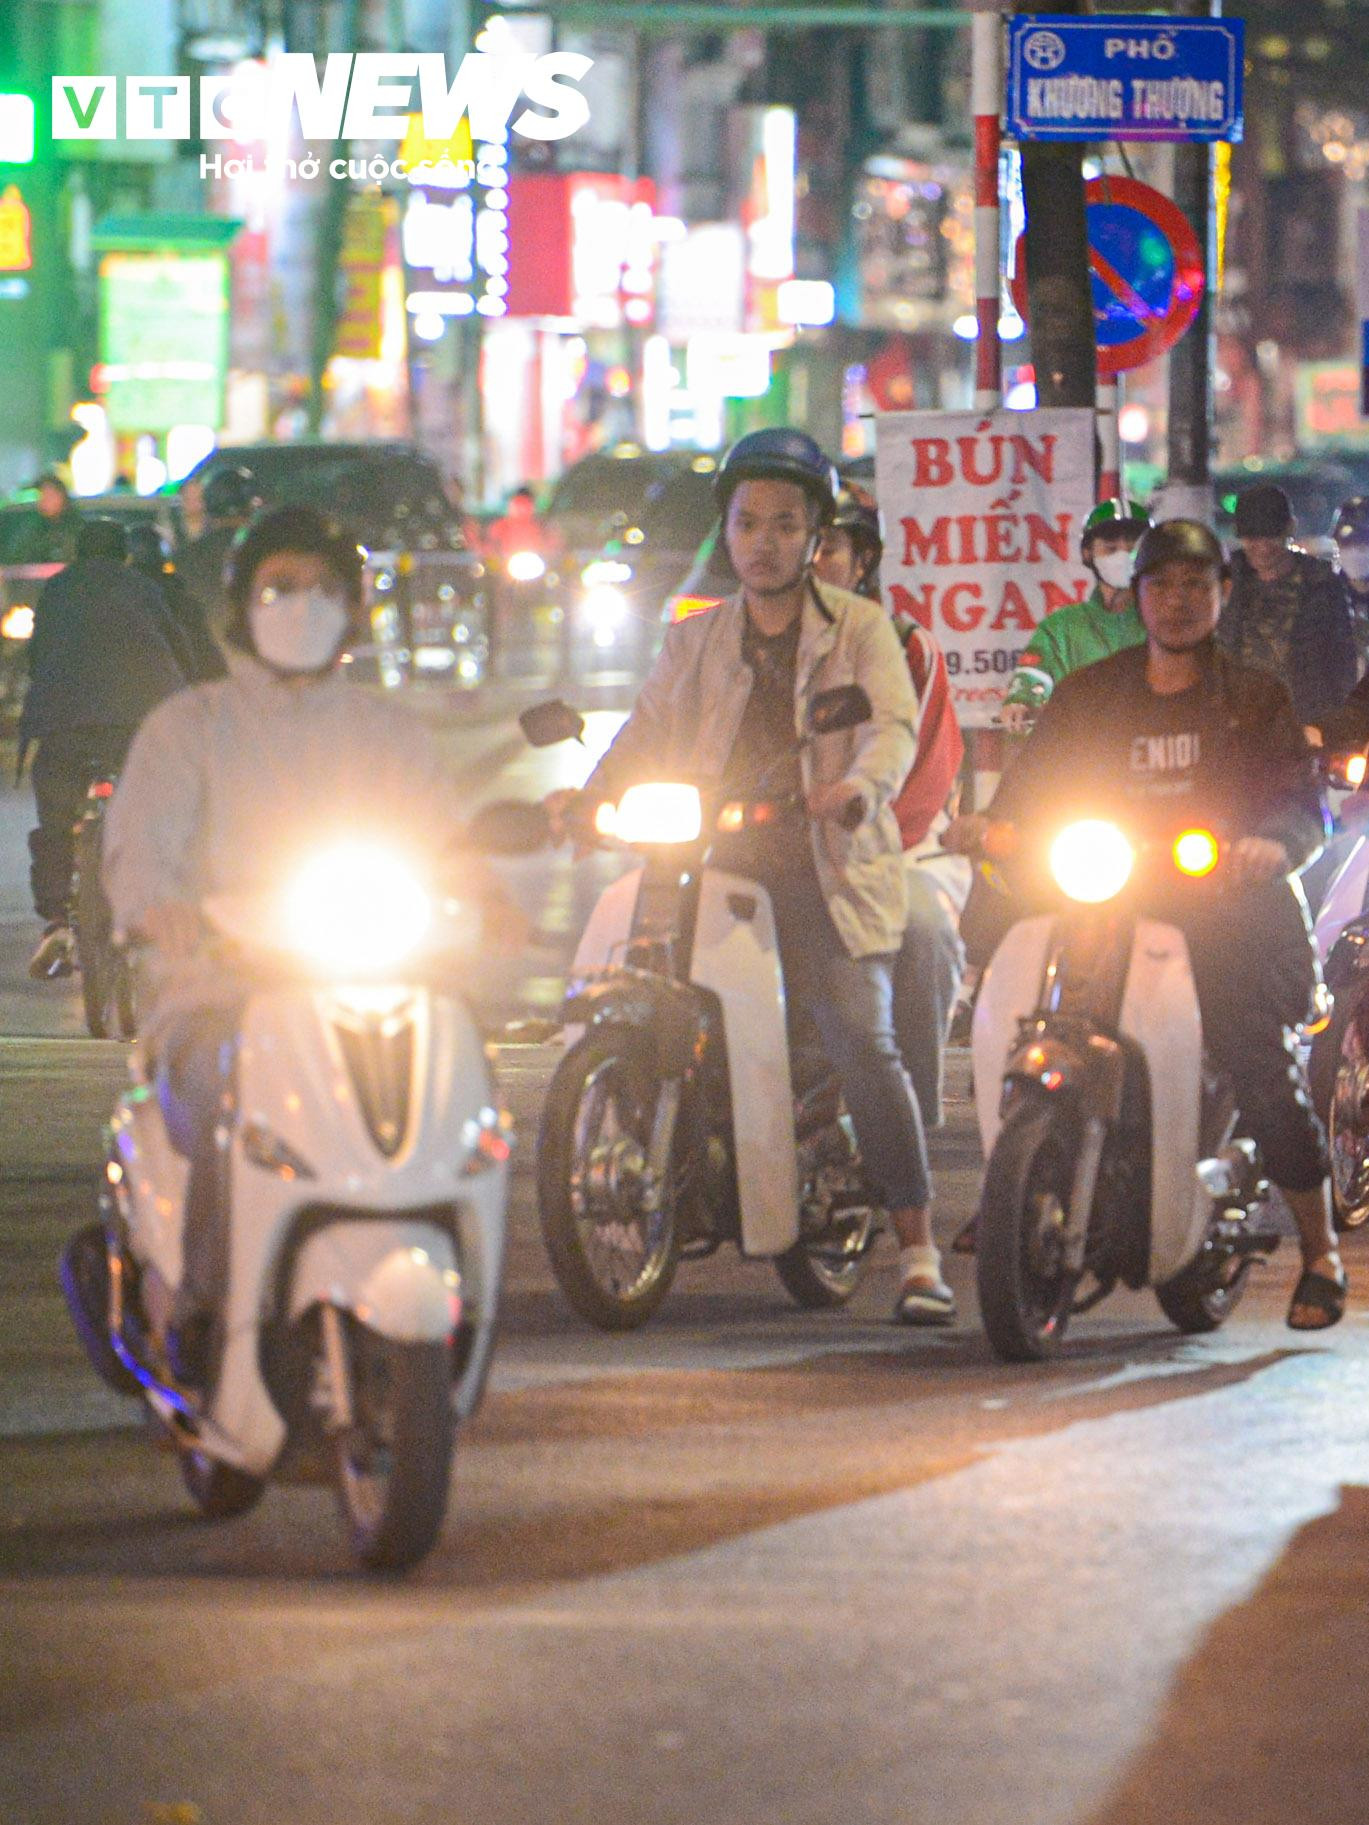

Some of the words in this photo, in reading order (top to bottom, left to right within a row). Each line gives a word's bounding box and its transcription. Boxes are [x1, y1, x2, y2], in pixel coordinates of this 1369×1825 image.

[1104, 30, 1178, 60] PHỐ
[912, 420, 1058, 487] BÚN
[888, 578, 1089, 632] NGAN
